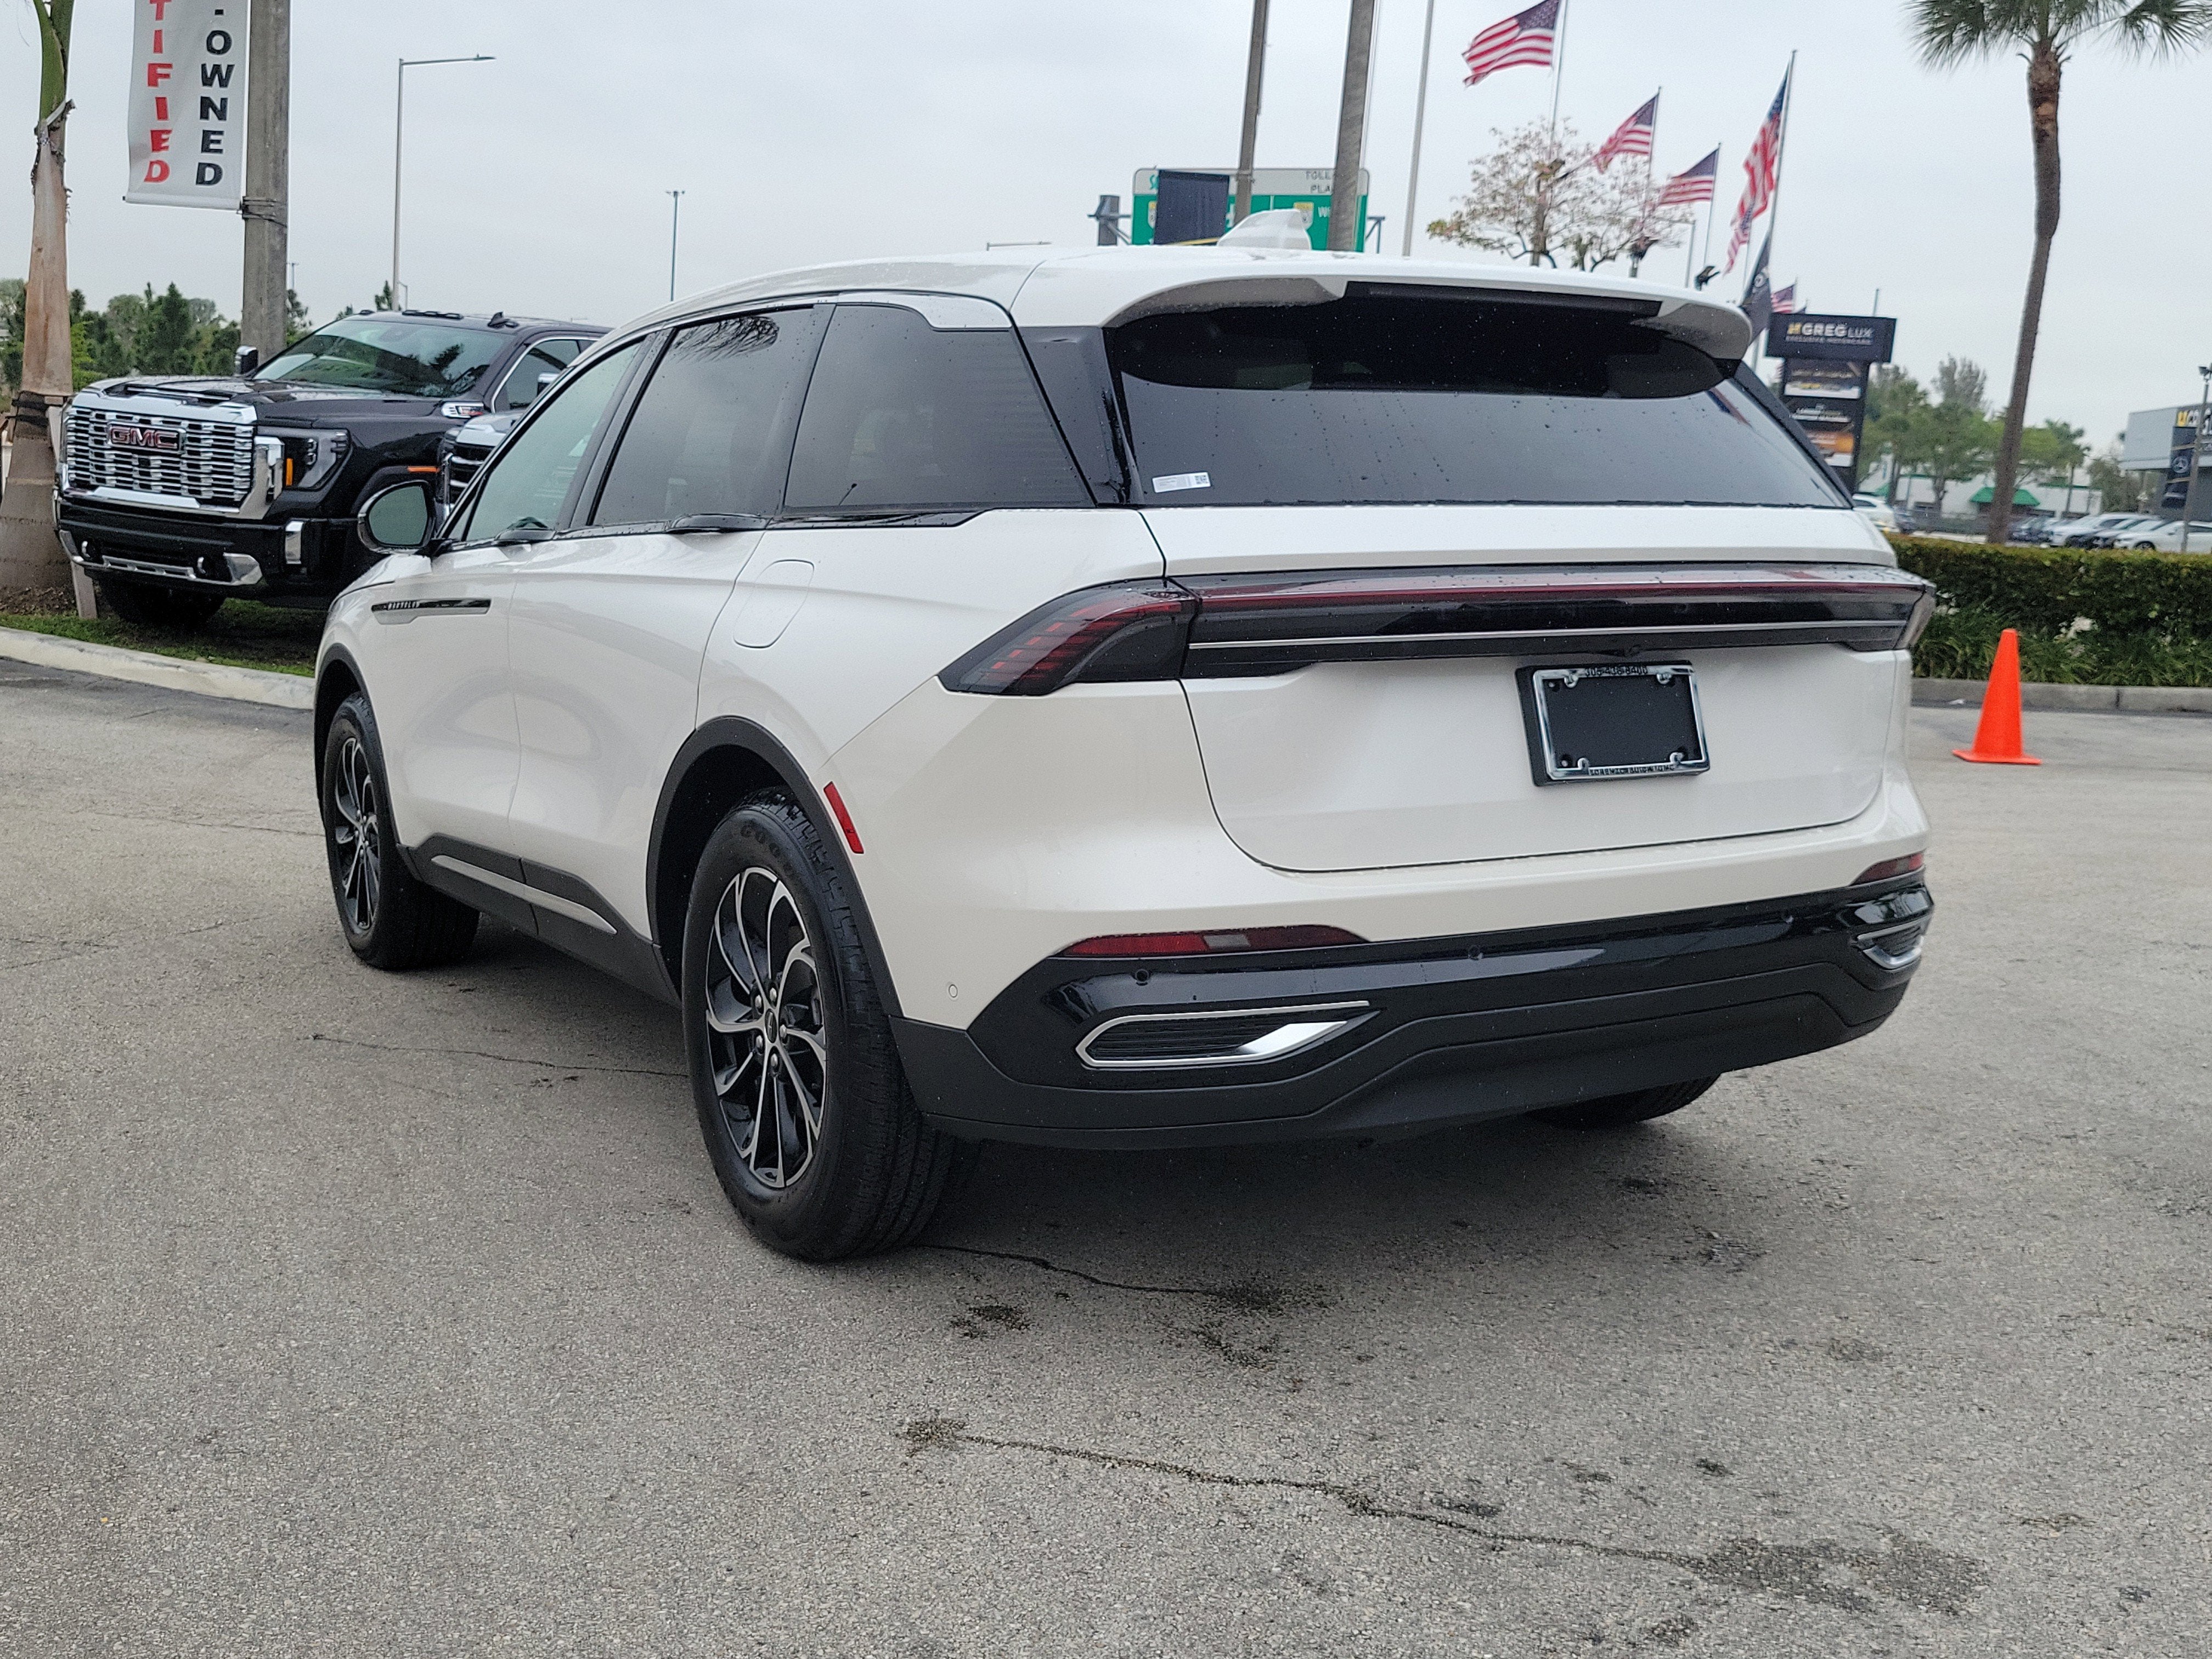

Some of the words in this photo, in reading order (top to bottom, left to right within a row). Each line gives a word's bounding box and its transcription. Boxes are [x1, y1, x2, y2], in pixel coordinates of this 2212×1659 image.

[1306, 171, 1331, 180] TOLL
[1310, 184, 1331, 193] PLA
[110, 426, 179, 449] GMC
